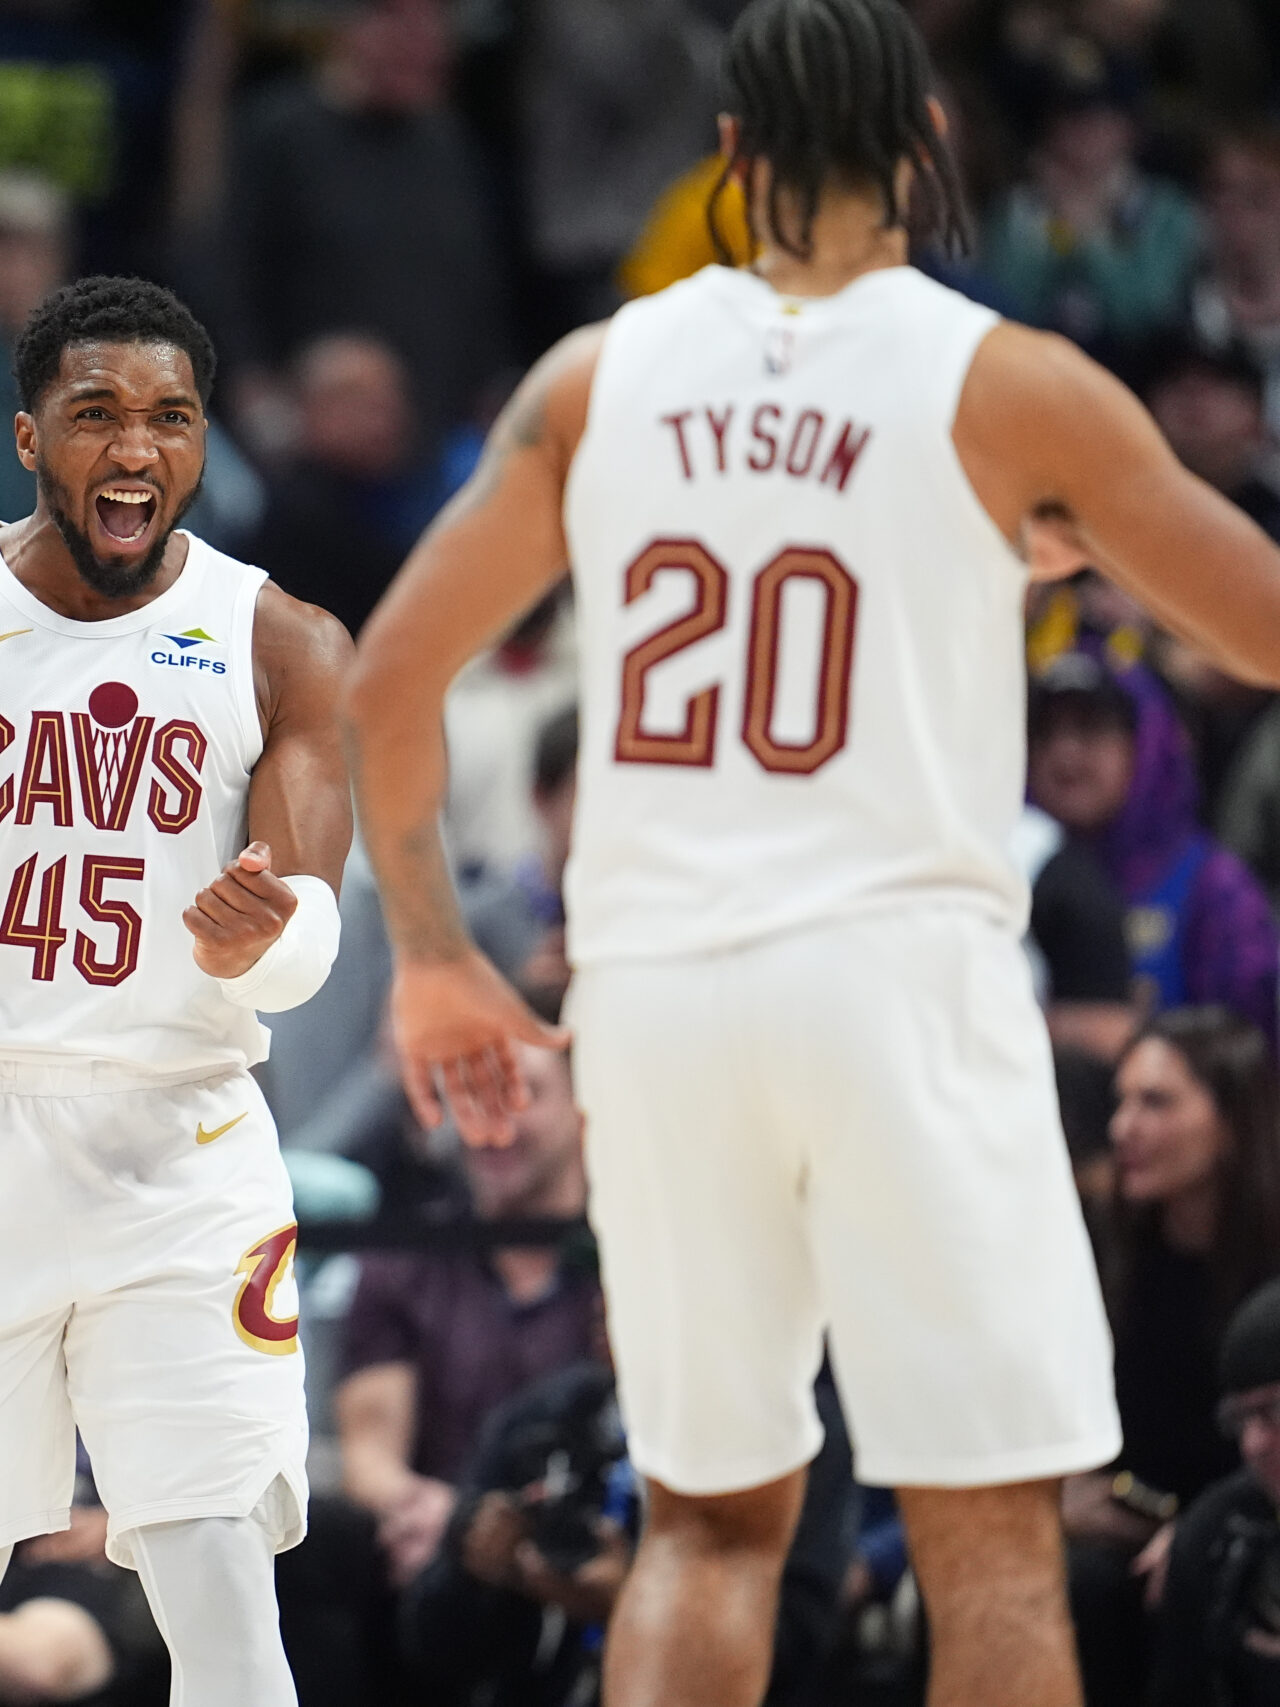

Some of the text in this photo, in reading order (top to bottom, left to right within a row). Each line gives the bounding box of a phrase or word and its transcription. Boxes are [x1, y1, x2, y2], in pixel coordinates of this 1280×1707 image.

[659, 402, 873, 493] TYSON
[151, 651, 226, 674] CLIFFS
[613, 534, 860, 777] 20
